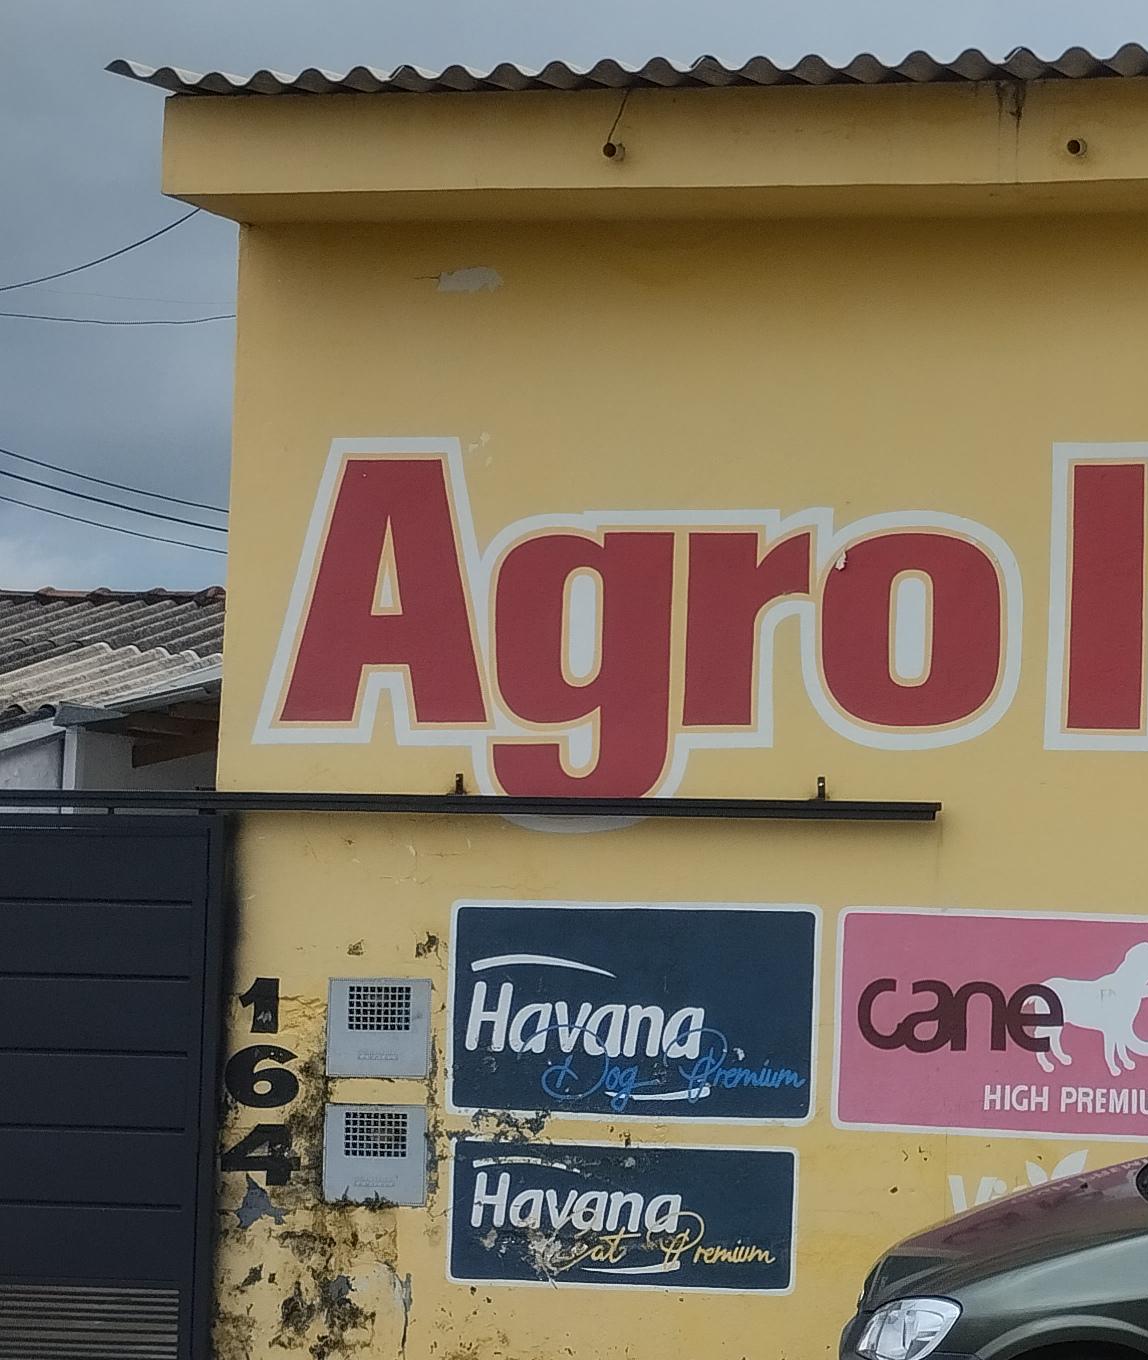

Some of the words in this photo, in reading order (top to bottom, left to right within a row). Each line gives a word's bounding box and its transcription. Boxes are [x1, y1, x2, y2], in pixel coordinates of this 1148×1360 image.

[277, 457, 1003, 800] Agro
[464, 980, 706, 1060] Havana
[856, 977, 1065, 1054] cane
[517, 1023, 660, 1112] Dog
[662, 1027, 806, 1104] Premium
[982, 1084, 1050, 1113] HIGH
[470, 1171, 683, 1234] Havana
[646, 1210, 776, 1273] Premium
